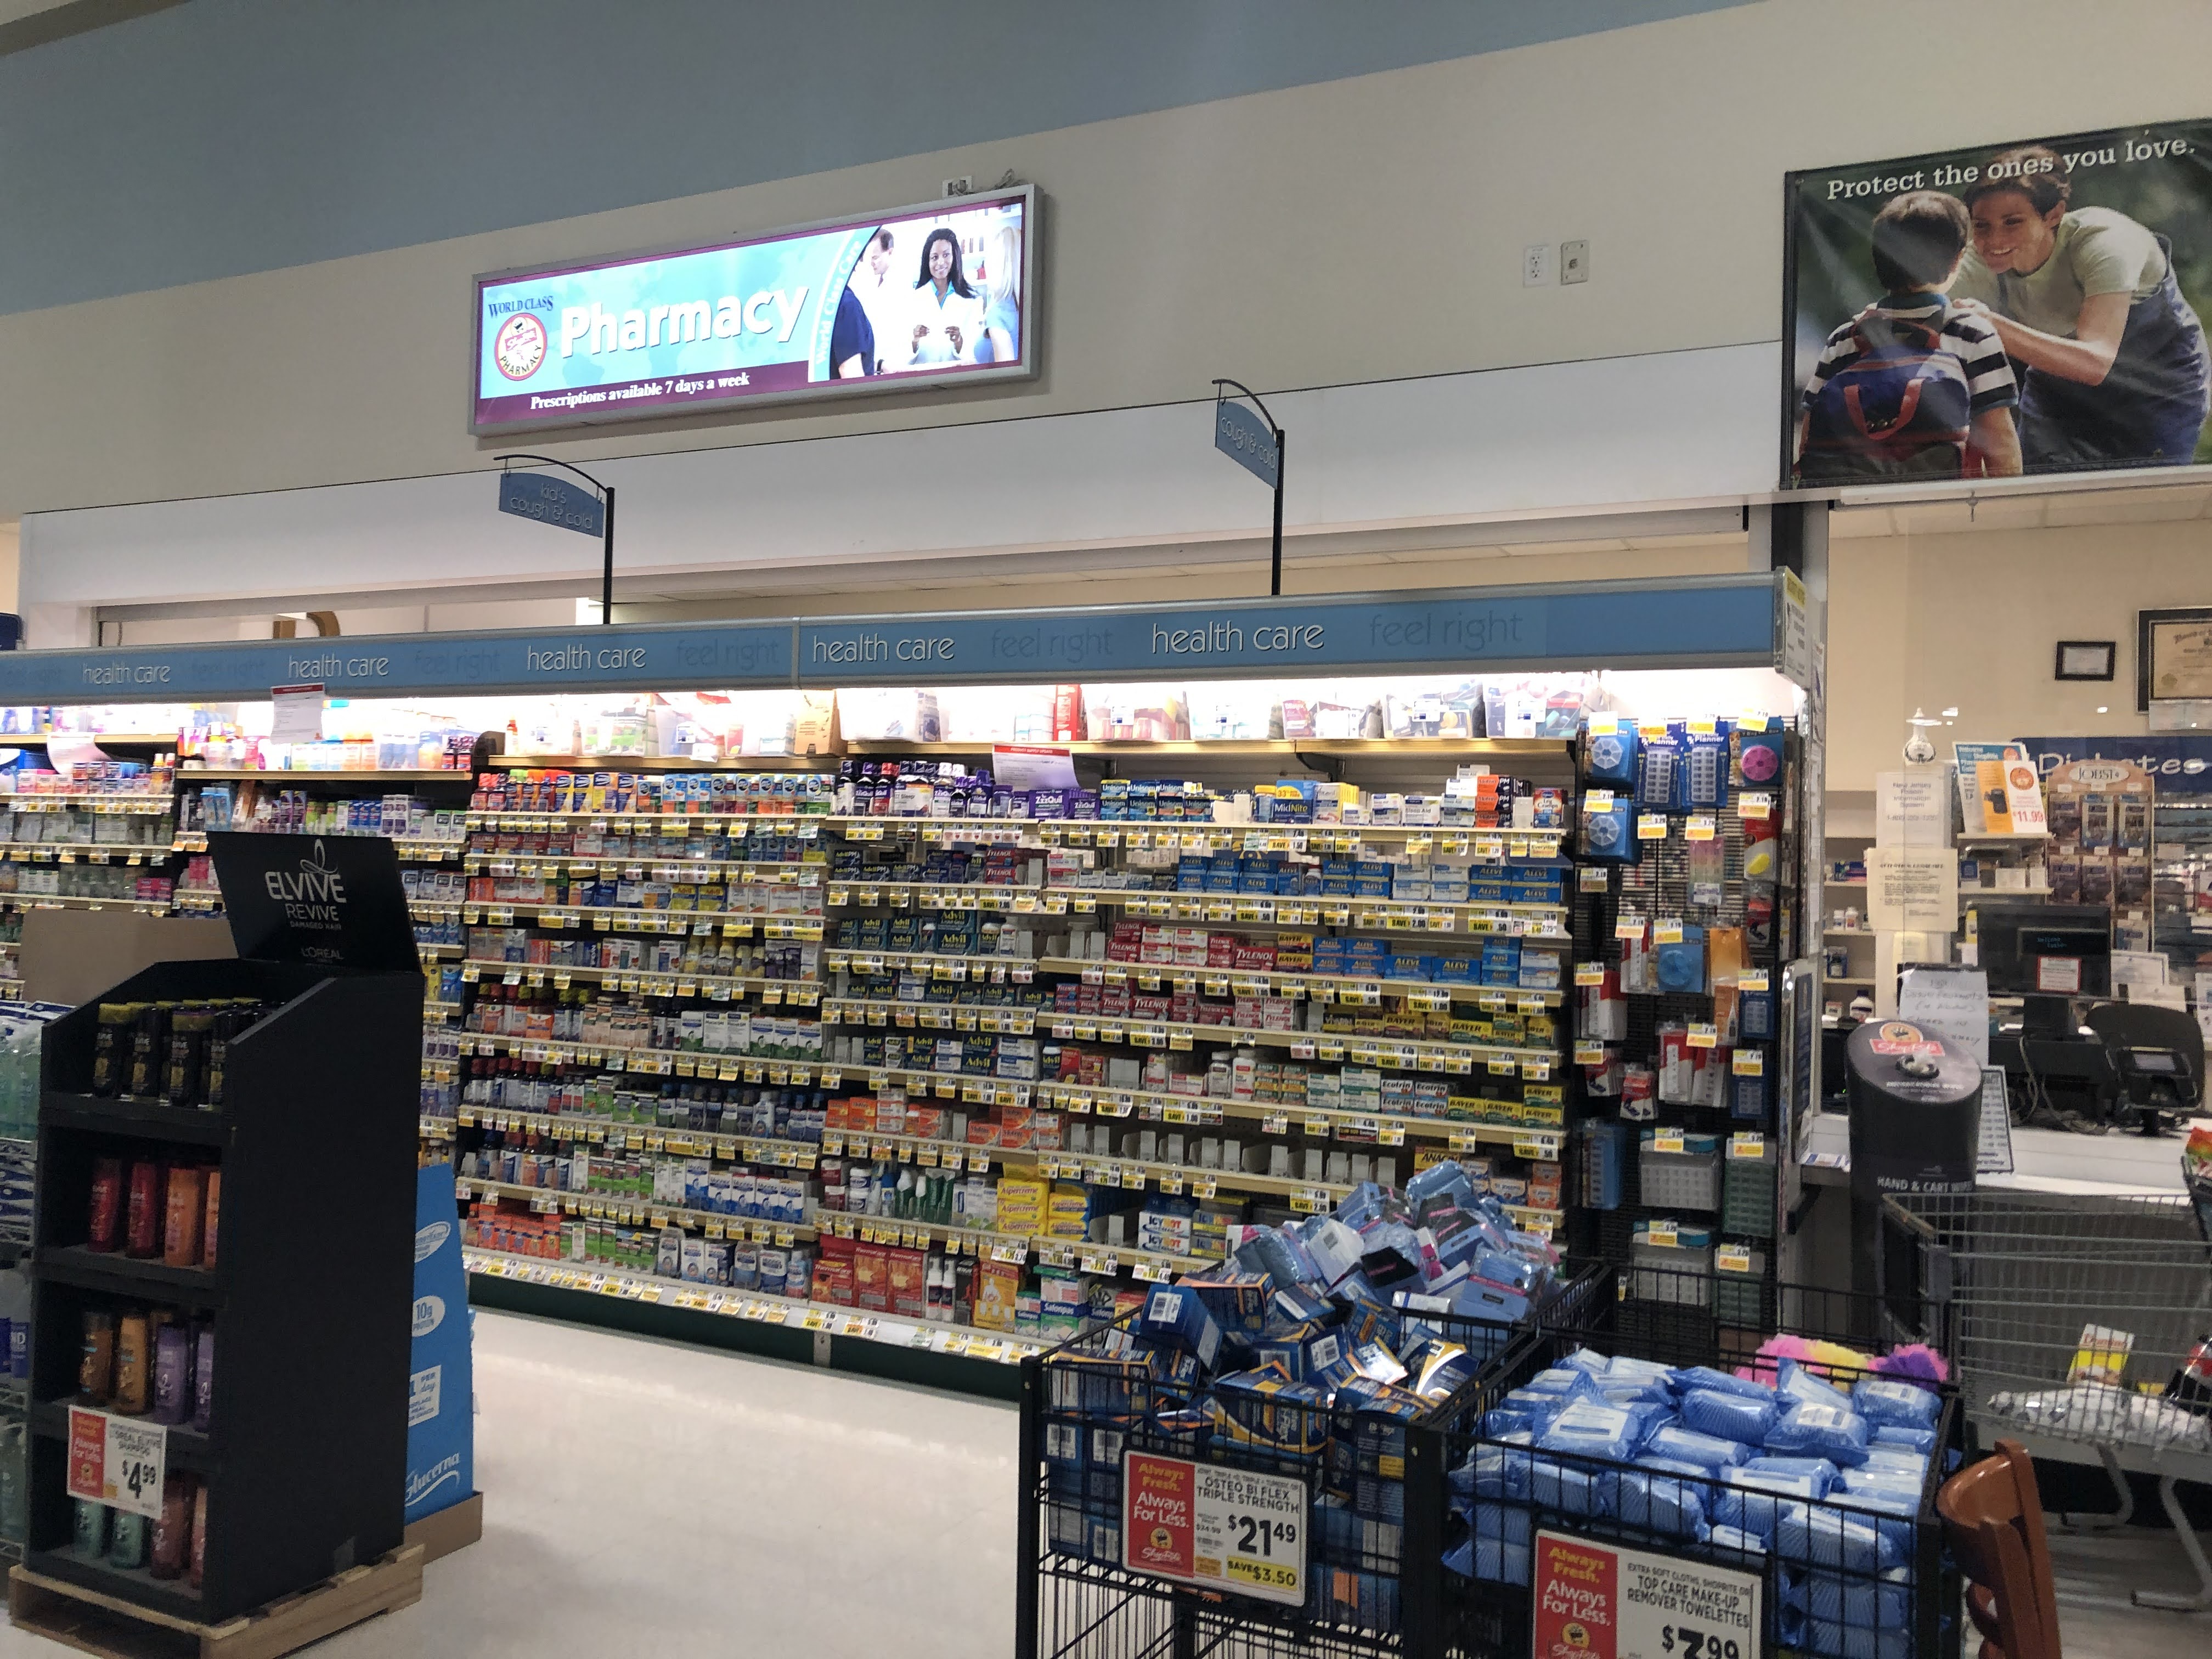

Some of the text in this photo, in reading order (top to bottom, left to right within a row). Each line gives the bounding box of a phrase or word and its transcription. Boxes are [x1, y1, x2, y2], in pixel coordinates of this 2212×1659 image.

[1827, 137, 2195, 201] Protect the ones you love.
[488, 296, 554, 318] WORLD CLASS
[561, 286, 809, 359] Pharmacy
[500, 345, 541, 375] PHARMACY
[531, 373, 750, 409] Prescriptions available 7 days a week
[566, 513, 593, 529] cold
[1373, 610, 1523, 651] feel right
[1152, 620, 1325, 654] health care
[813, 633, 956, 663] health care
[991, 627, 1114, 663] feel right
[526, 643, 647, 671] health care
[287, 651, 390, 679] health care
[83, 660, 131, 685] health
[134, 665, 171, 683] care
[1102, 784, 1126, 792] Unisom
[1130, 783, 1157, 792] Unisom
[1159, 783, 1183, 792] Unisom
[1035, 793, 1063, 805] ZzzQuil
[1274, 803, 1308, 813] MidNite
[265, 871, 347, 903] ELVIVE
[285, 904, 339, 921] REVIVE
[941, 910, 965, 920] Advil
[1115, 922, 1140, 930] TYLENOL
[1412, 919, 1426, 928] 2.00
[941, 934, 966, 944] Advil
[1111, 943, 1137, 952] TYLENOL
[1236, 948, 1273, 961] TYLENOL
[1278, 956, 1303, 964] BAYER
[1395, 958, 1420, 968] ALEVE
[1443, 961, 1469, 971] ALEVE
[873, 985, 893, 994] Advil
[930, 985, 953, 994] Advil
[1134, 998, 1169, 1009] TYLENOL
[1386, 1016, 1414, 1025] BAYER
[1452, 1023, 1481, 1032] BAYER
[915, 1036, 933, 1045] Advil
[967, 1036, 991, 1046] Advil
[912, 1054, 930, 1063] Advil
[966, 1057, 990, 1067] Advil
[1383, 1080, 1411, 1090] Ecotrin
[1416, 1084, 1444, 1093] Ecotrin
[1526, 1087, 1553, 1097] BAYER
[1382, 1099, 1412, 1109] Ecotrin
[1415, 1101, 1445, 1111] Ecotrin
[1449, 1099, 1475, 1109] BAYER
[1487, 1102, 1513, 1112] BAYER
[1526, 1109, 1552, 1119] BAYER
[1877, 1176, 1909, 1190] HAND
[1911, 1181, 1920, 1192] &
[1001, 1186, 1039, 1197] Aspercreme
[1002, 1204, 1040, 1214] Aspercreme
[1149, 1215, 1163, 1226] ICY
[1149, 1234, 1163, 1245] ICY
[416, 1301, 433, 1321] 10g
[1044, 1302, 1074, 1315] Salonpas
[420, 1383, 436, 1393] day
[1138, 1462, 1185, 1481] Always
[1142, 1476, 1181, 1493] Fresh.
[1205, 1476, 1243, 1493] OSTEO
[1246, 1483, 1258, 1496] BI
[1261, 1486, 1289, 1500] FLEX
[1137, 1491, 1186, 1514] Always
[1197, 1486, 1299, 1514] TRIPLE STRENGTH
[1133, 1508, 1156, 1522] For
[1159, 1513, 1190, 1528] Less.
[1549, 1546, 1606, 1570] Always
[1228, 1560, 1296, 1587] SAVE $3.50
[1554, 1562, 1600, 1584] Fresh.
[1546, 1579, 1606, 1608] Always
[1638, 1575, 1740, 1609] TOP CARE MAKE-UP
[1543, 1595, 1611, 1626] For Less.
[1627, 1587, 1750, 1628] REMOVER TOWELETTES
